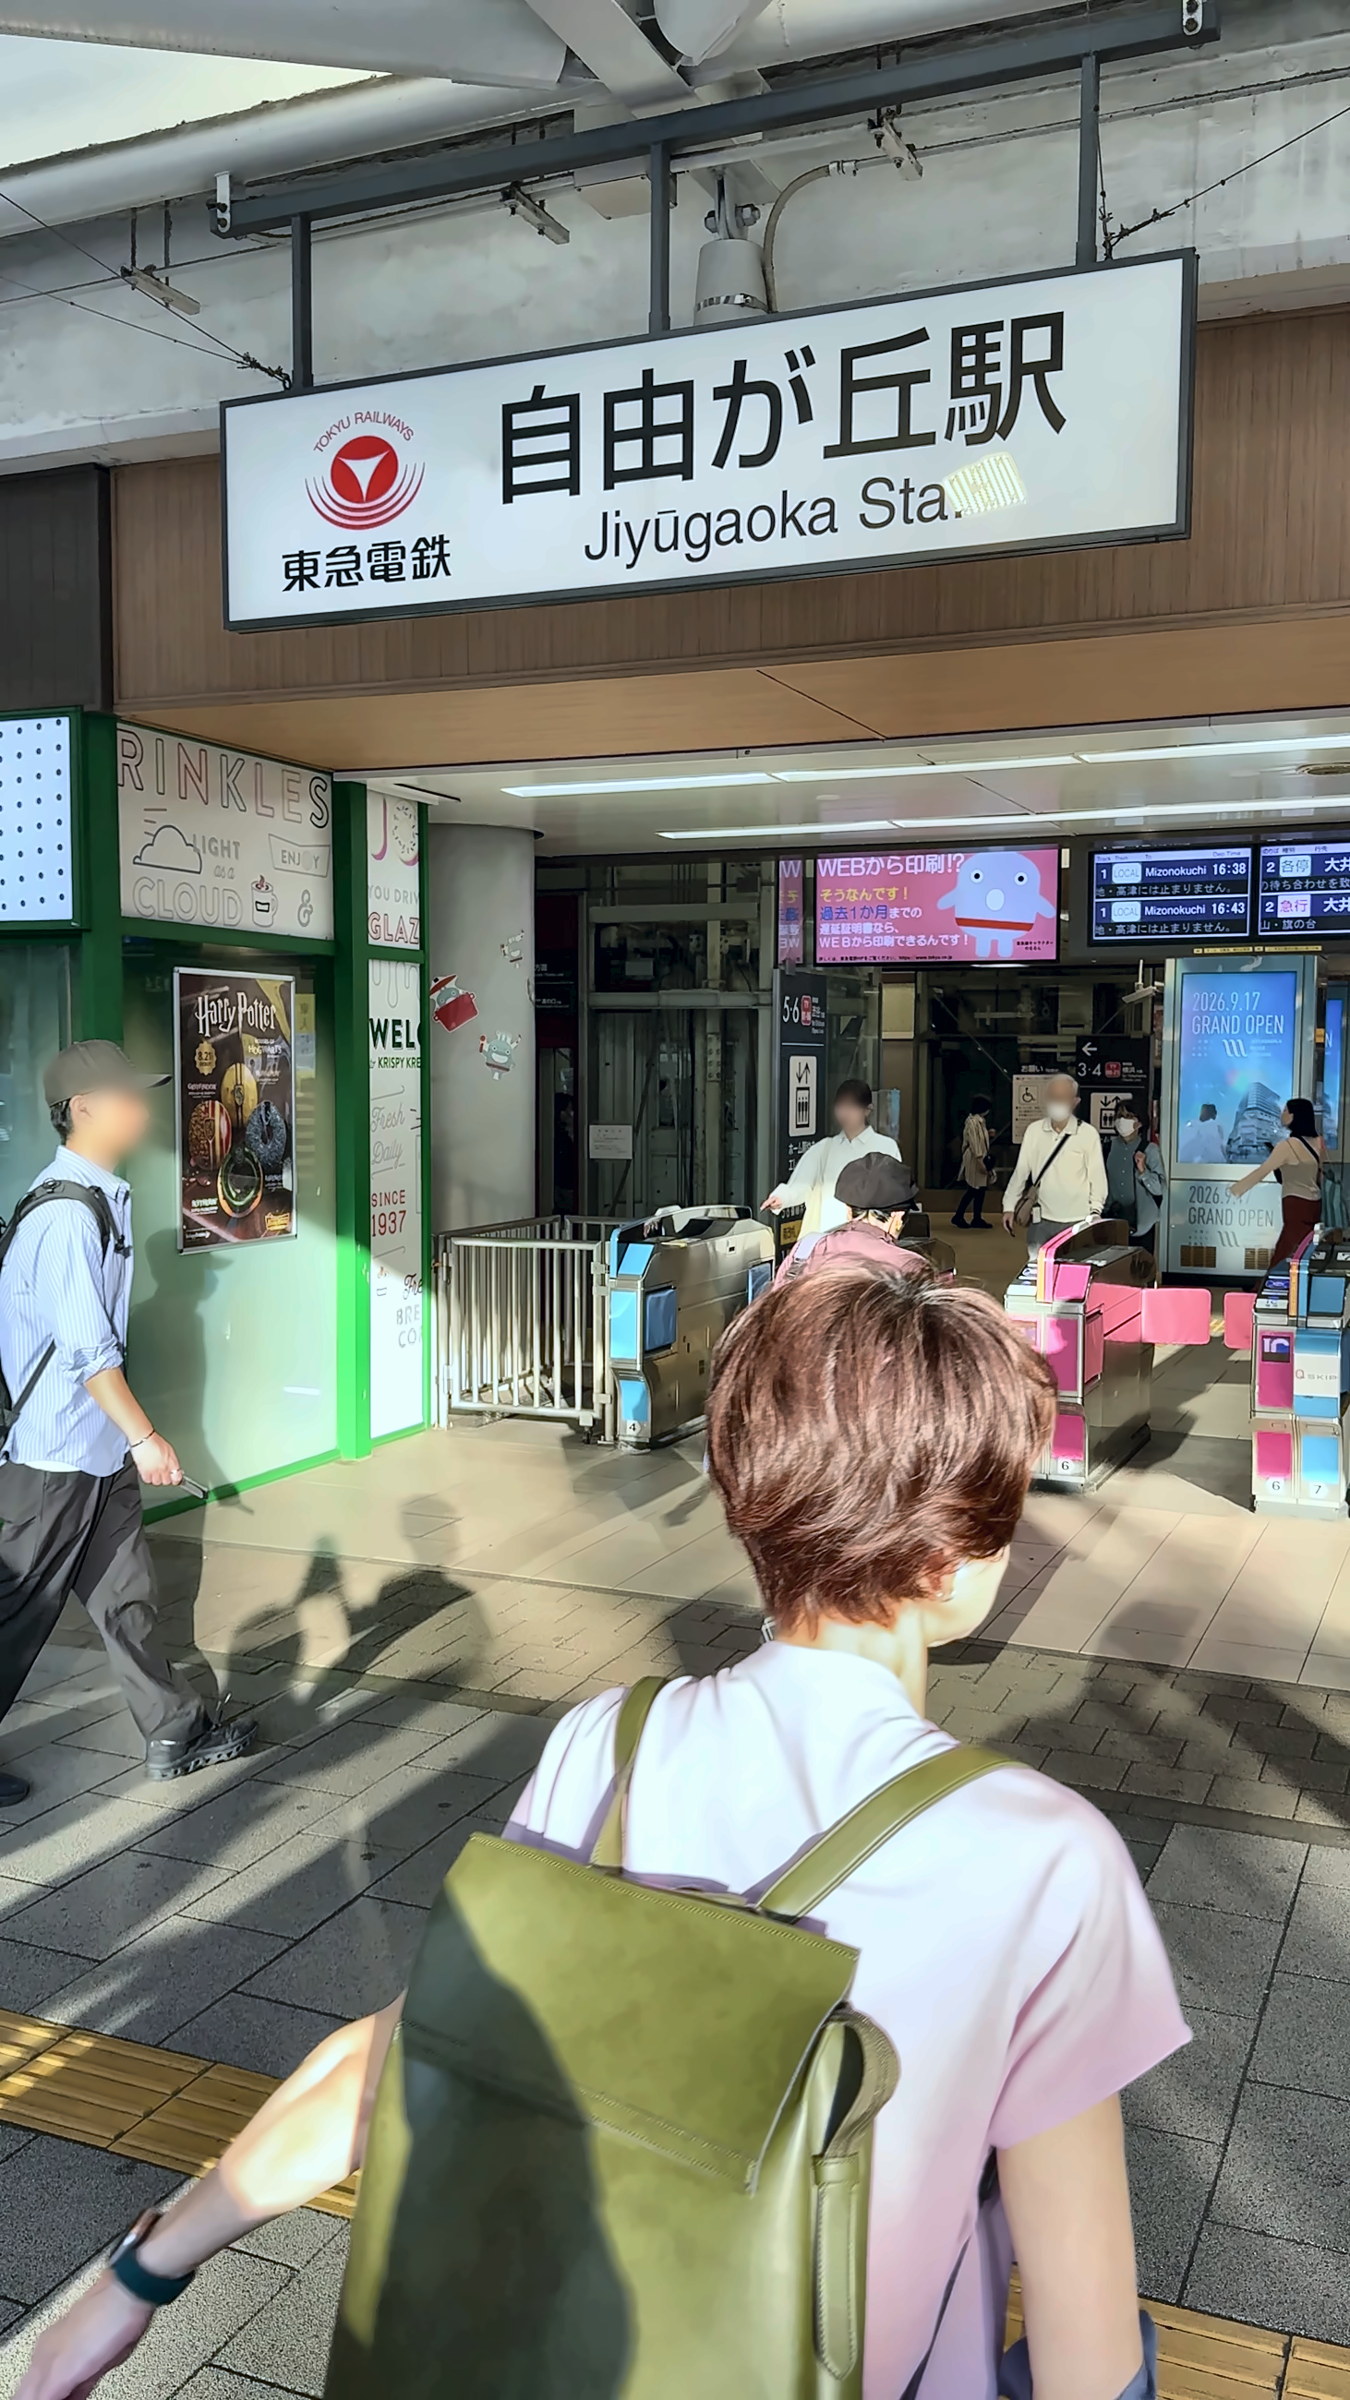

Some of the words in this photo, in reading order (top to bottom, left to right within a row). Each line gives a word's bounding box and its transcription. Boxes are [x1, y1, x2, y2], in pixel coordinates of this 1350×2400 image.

[502, 311, 1066, 505] 自由が丘駅
[313, 416, 351, 453] TOKYU
[354, 411, 414, 441] RAILWAYS
[584, 490, 838, 570] Jiyūgaoka
[282, 534, 452, 592] 東急電鉄
[117, 728, 329, 829] RINKLES
[193, 834, 240, 860] LIGHT
[1101, 869, 1107, 879] 1
[1113, 868, 1140, 879] LOCAL
[1145, 864, 1207, 877] Mizonokuchi
[1212, 862, 1246, 876] 16:38
[1266, 862, 1276, 873] 2
[1281, 859, 1309, 873] 各停
[1324, 856, 1350, 873] 大井
[133, 876, 243, 927] CLOUD
[1100, 908, 1106, 917] 1
[1112, 907, 1139, 917] LOCAL
[1144, 904, 1206, 916] Mizonokuchi
[1211, 902, 1246, 915] 16:43
[1265, 901, 1275, 913] 2
[1280, 899, 1308, 913] 急行
[1323, 896, 1350, 913] 大井
[368, 911, 419, 944] GLAZ
[1192, 991, 1261, 1012] 2026.9.17
[195, 994, 236, 1037] Harry
[236, 992, 277, 1039] Potter
[1192, 1015, 1241, 1035] GRAND
[1245, 1015, 1284, 1034] OPEN
[369, 1017, 421, 1050] WEL
[378, 1056, 404, 1069] KRISPY
[406, 1056, 421, 1069] KRE
[371, 1103, 405, 1133] Fresh
[371, 1140, 404, 1166] Daily
[371, 1190, 406, 1208] SINCE
[371, 1210, 407, 1237] 1937
[1188, 1206, 1233, 1226] GRAND
[1238, 1209, 1274, 1227] OPEN
[397, 1304, 420, 1325] BRE
[399, 1328, 422, 1348] CO
[629, 1422, 636, 1432] 4
[1061, 1460, 1070, 1471] 6
[1271, 1480, 1281, 1492] 6
[1313, 1484, 1323, 1495] 7
